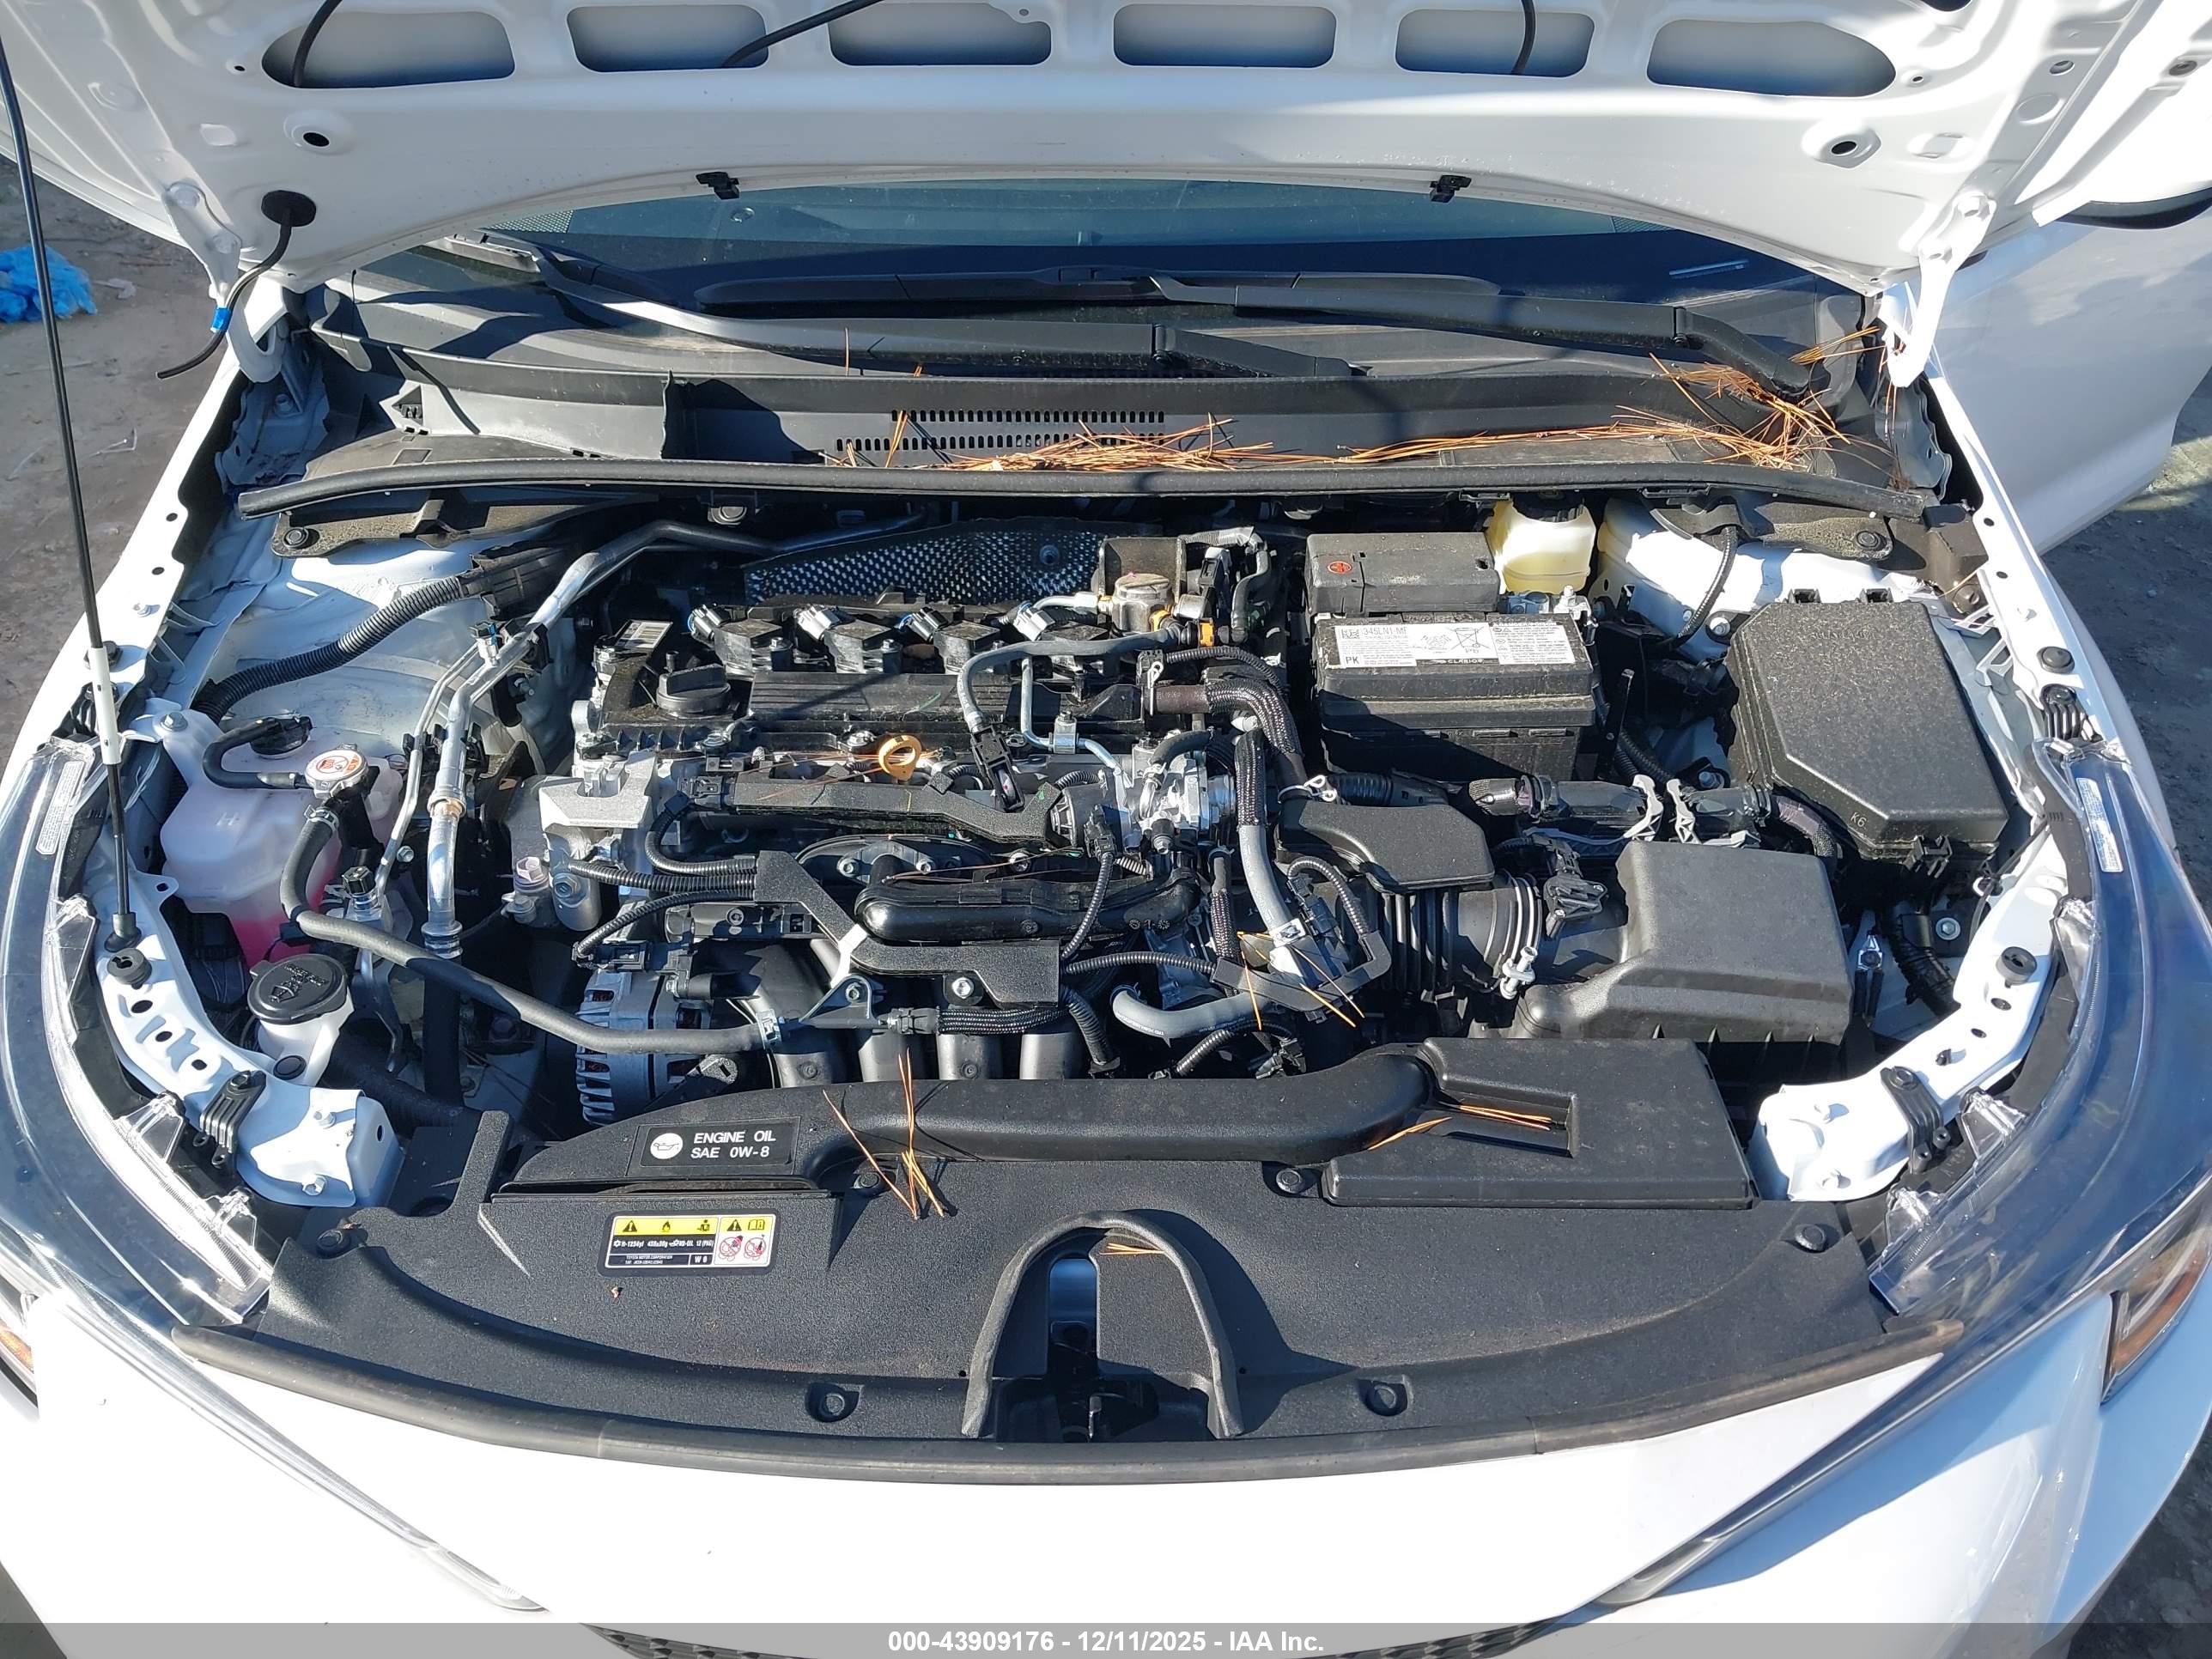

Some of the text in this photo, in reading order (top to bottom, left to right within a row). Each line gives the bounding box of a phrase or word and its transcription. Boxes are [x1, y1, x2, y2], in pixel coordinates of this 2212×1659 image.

[1850, 811, 1867, 828] K6
[693, 1130, 776, 1144] ENGINE OIL
[690, 1146, 770, 1159] SAE 0W-8
